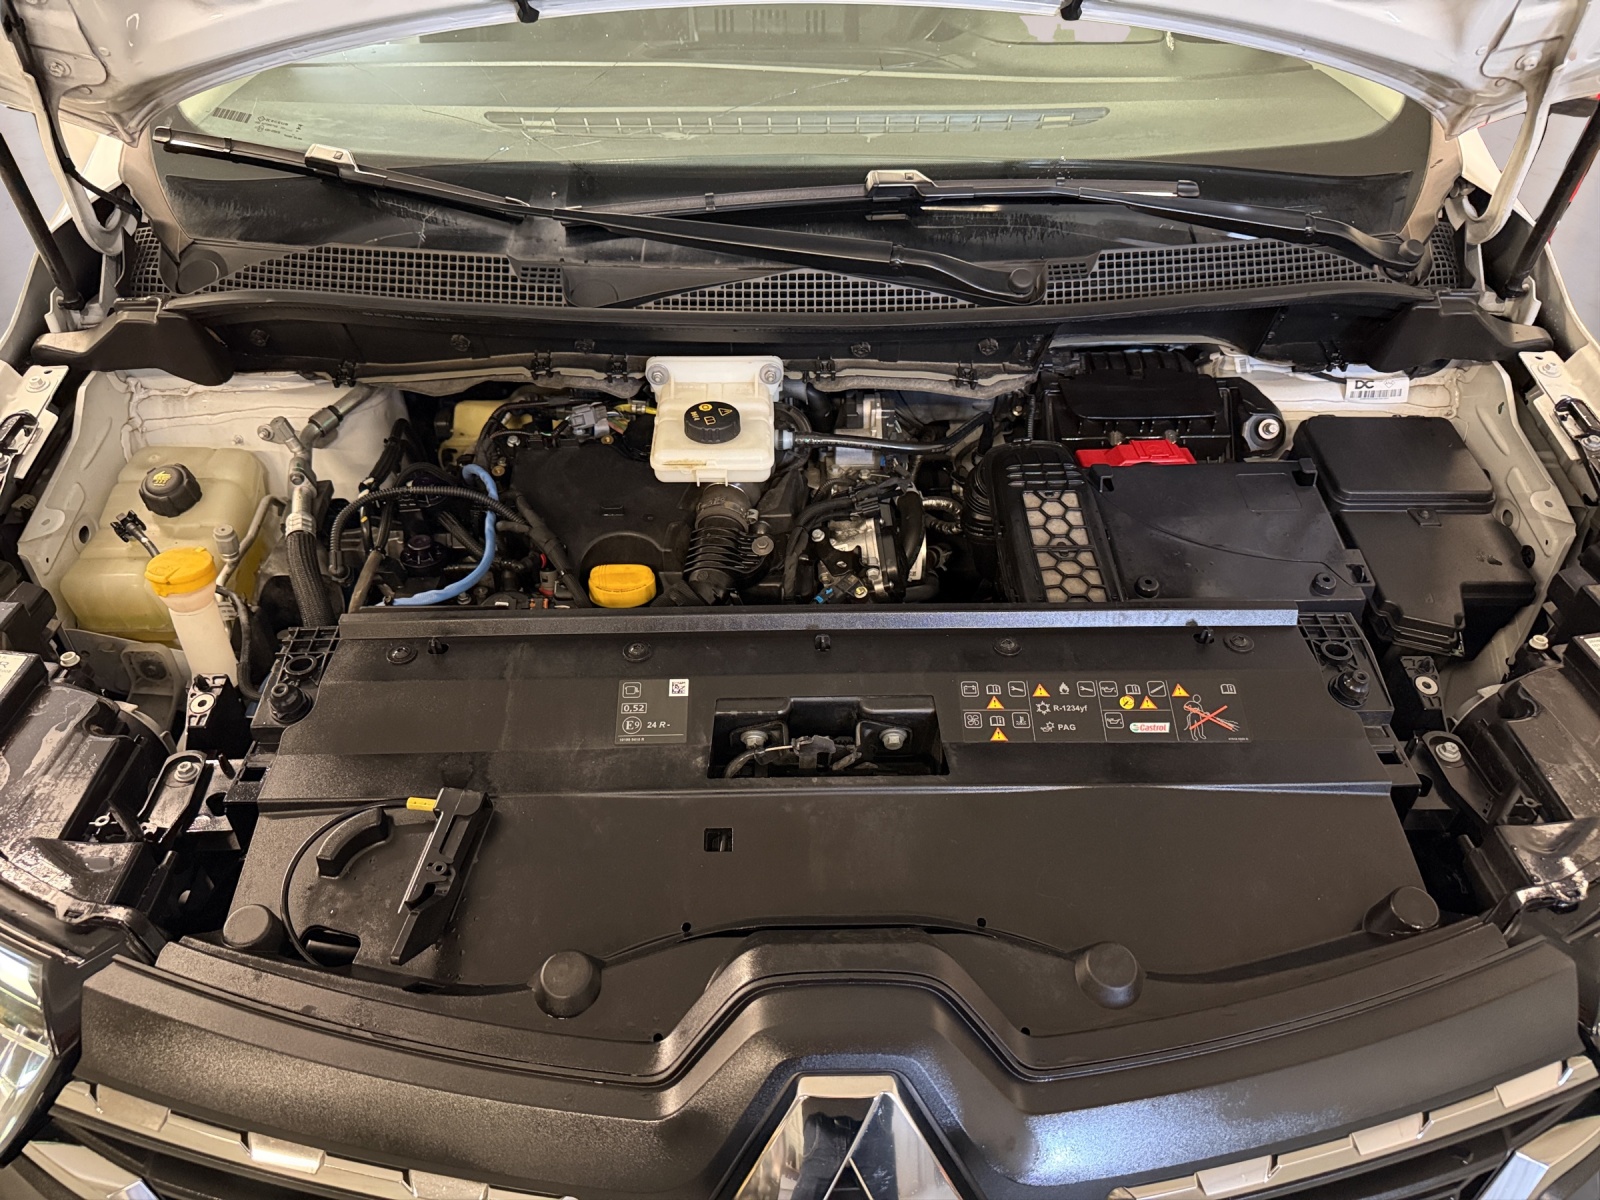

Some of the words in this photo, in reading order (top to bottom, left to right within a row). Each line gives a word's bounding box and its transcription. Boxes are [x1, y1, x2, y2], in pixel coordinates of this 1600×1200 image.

[623, 704, 645, 713] 0,52
[1053, 704, 1088, 713] R-1234yf
[625, 719, 640, 730] E9
[1057, 723, 1076, 731] PAG
[1139, 723, 1167, 732] Castrol
